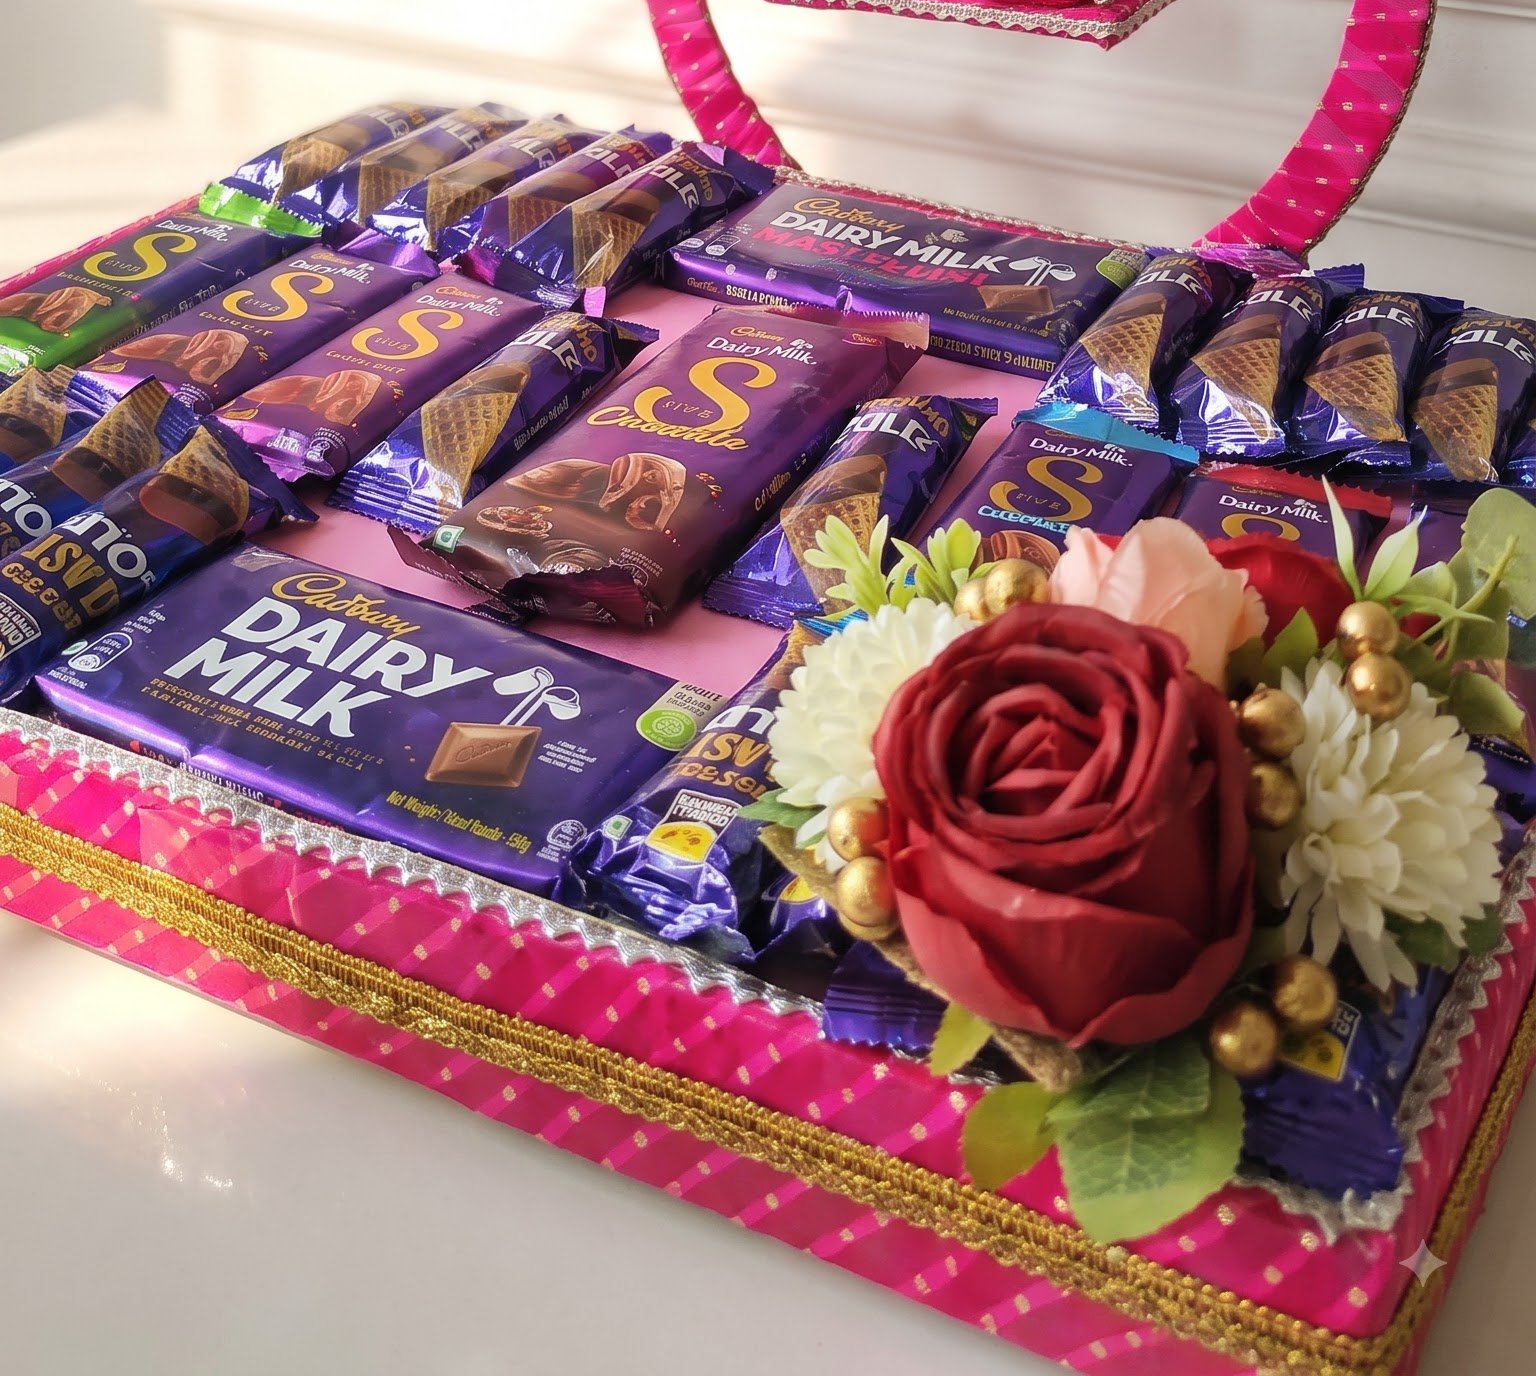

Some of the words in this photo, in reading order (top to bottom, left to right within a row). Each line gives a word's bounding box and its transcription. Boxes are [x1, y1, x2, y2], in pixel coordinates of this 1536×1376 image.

[769, 211, 902, 250] DAIRY
[893, 240, 1010, 274] MILK
[222, 271, 334, 321] S
[352, 308, 464, 360] S
[706, 337, 770, 358] Dairy
[633, 356, 777, 433] S
[1029, 437, 1086, 456] Dairy
[989, 455, 1103, 522] S
[1219, 495, 1279, 514] Dairy
[271, 573, 421, 641] Cadbury
[221, 596, 495, 698] DAIRY
[163, 637, 393, 738] MILK
